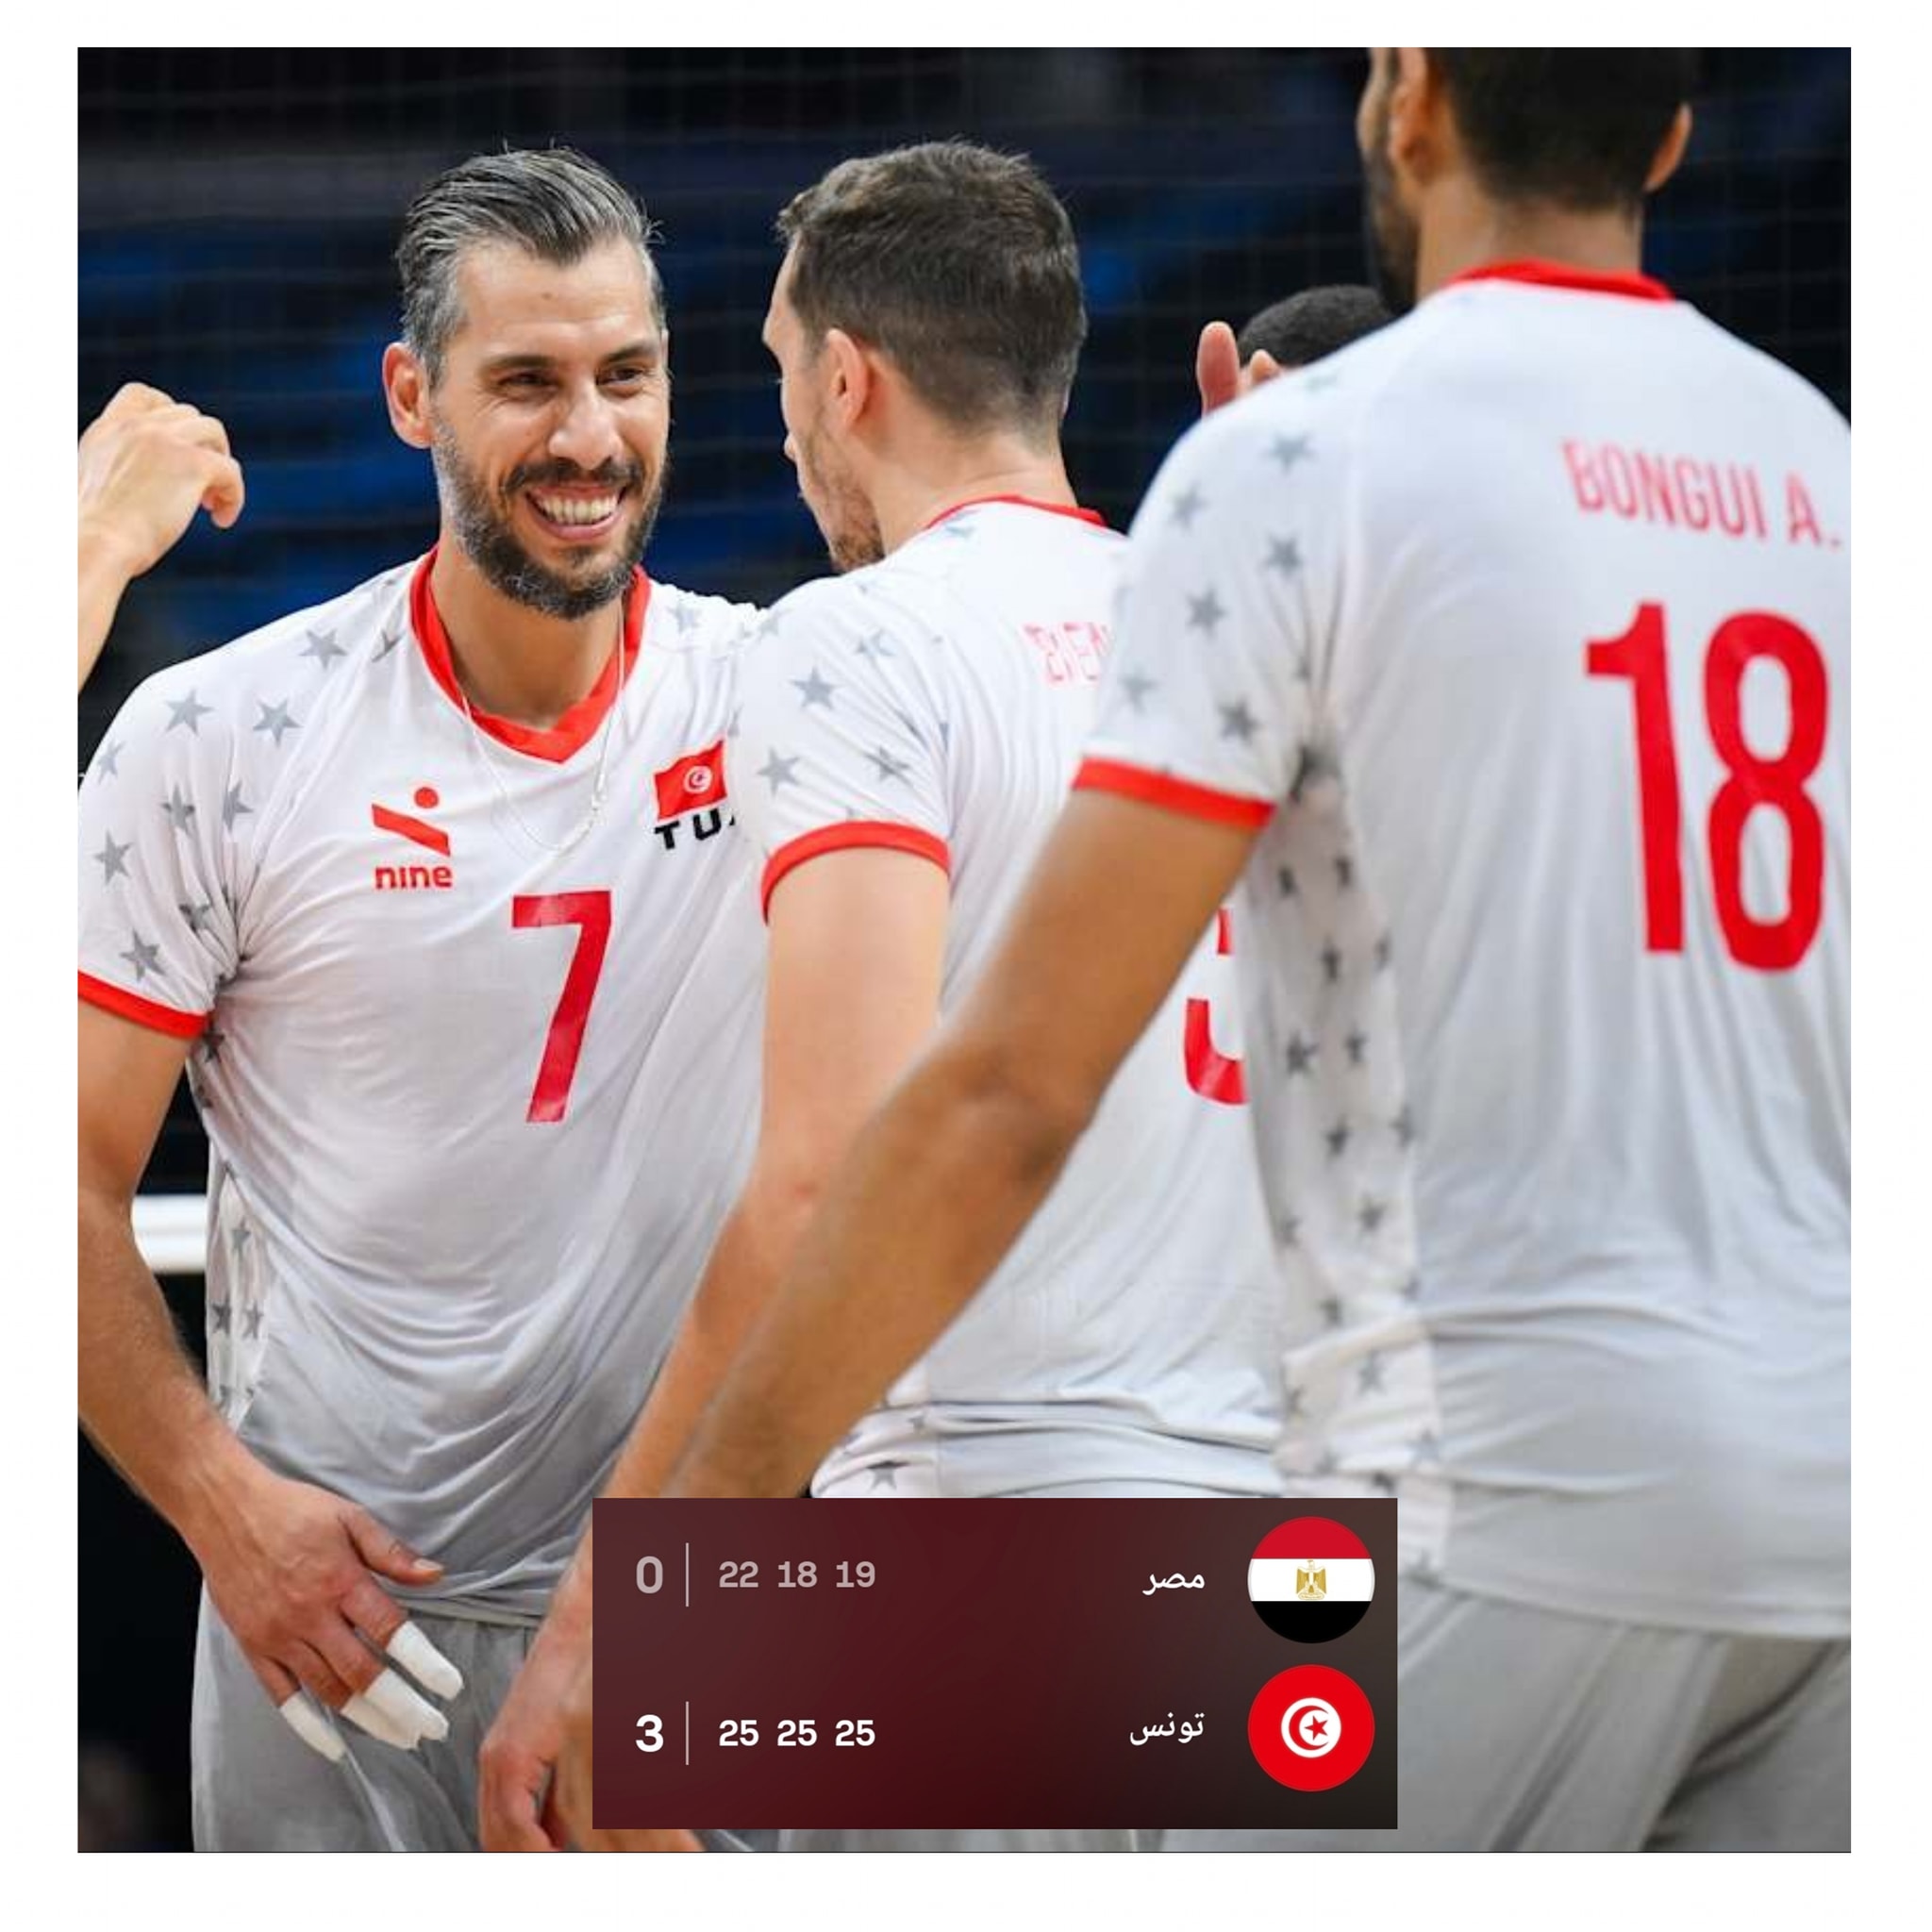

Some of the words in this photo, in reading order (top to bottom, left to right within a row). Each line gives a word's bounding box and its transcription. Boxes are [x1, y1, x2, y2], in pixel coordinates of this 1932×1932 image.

[1561, 439, 1770, 541] BONGUI
[1784, 472, 1844, 549] A.
[654, 808, 736, 850] TU
[1583, 601, 1831, 974] 18
[374, 864, 453, 890] nine
[510, 889, 613, 1124] 7
